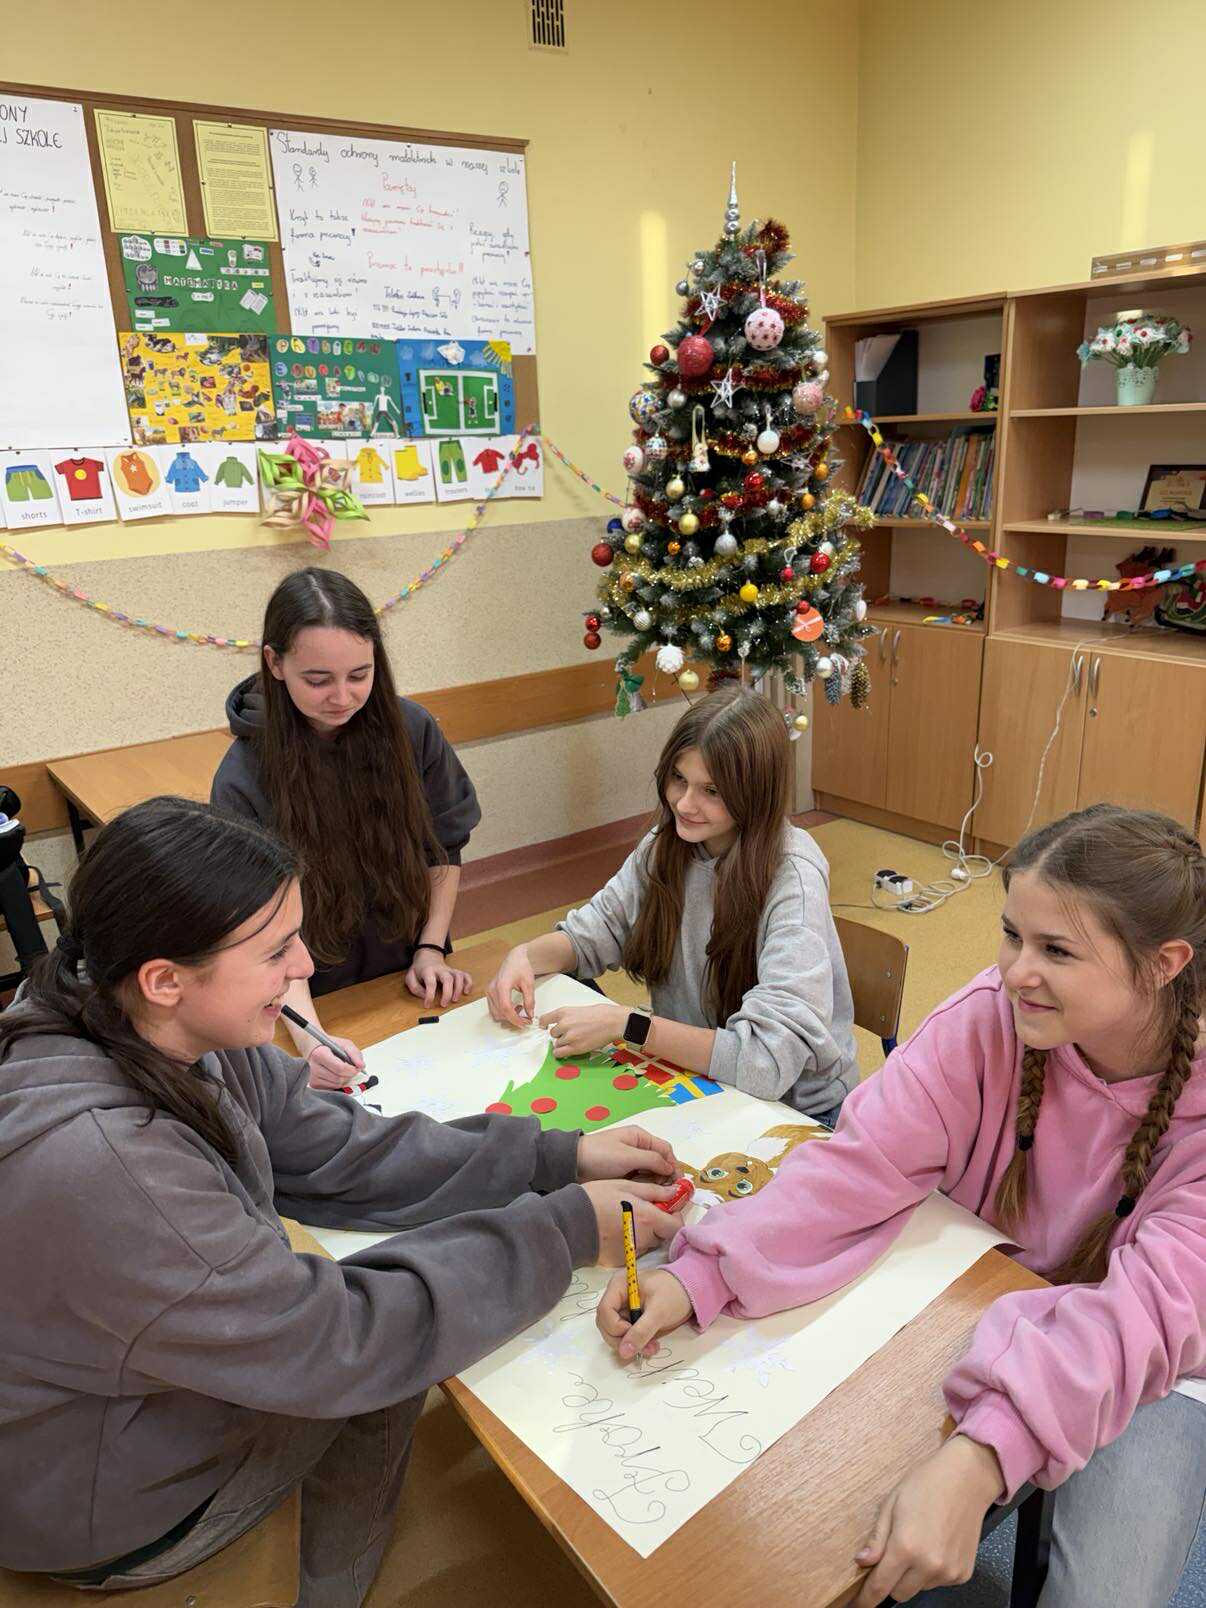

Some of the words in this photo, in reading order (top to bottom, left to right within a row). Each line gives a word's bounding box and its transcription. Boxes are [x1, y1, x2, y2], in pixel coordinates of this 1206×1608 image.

[15, 128, 63, 149] SZKOLE
[276, 131, 330, 163] Standardy
[340, 144, 379, 168] ochrony
[128, 502, 163, 513] swimsuit
[181, 500, 199, 508] coat
[223, 499, 249, 508] jumper
[20, 511, 48, 521] shorts
[75, 506, 103, 517] T-shirt
